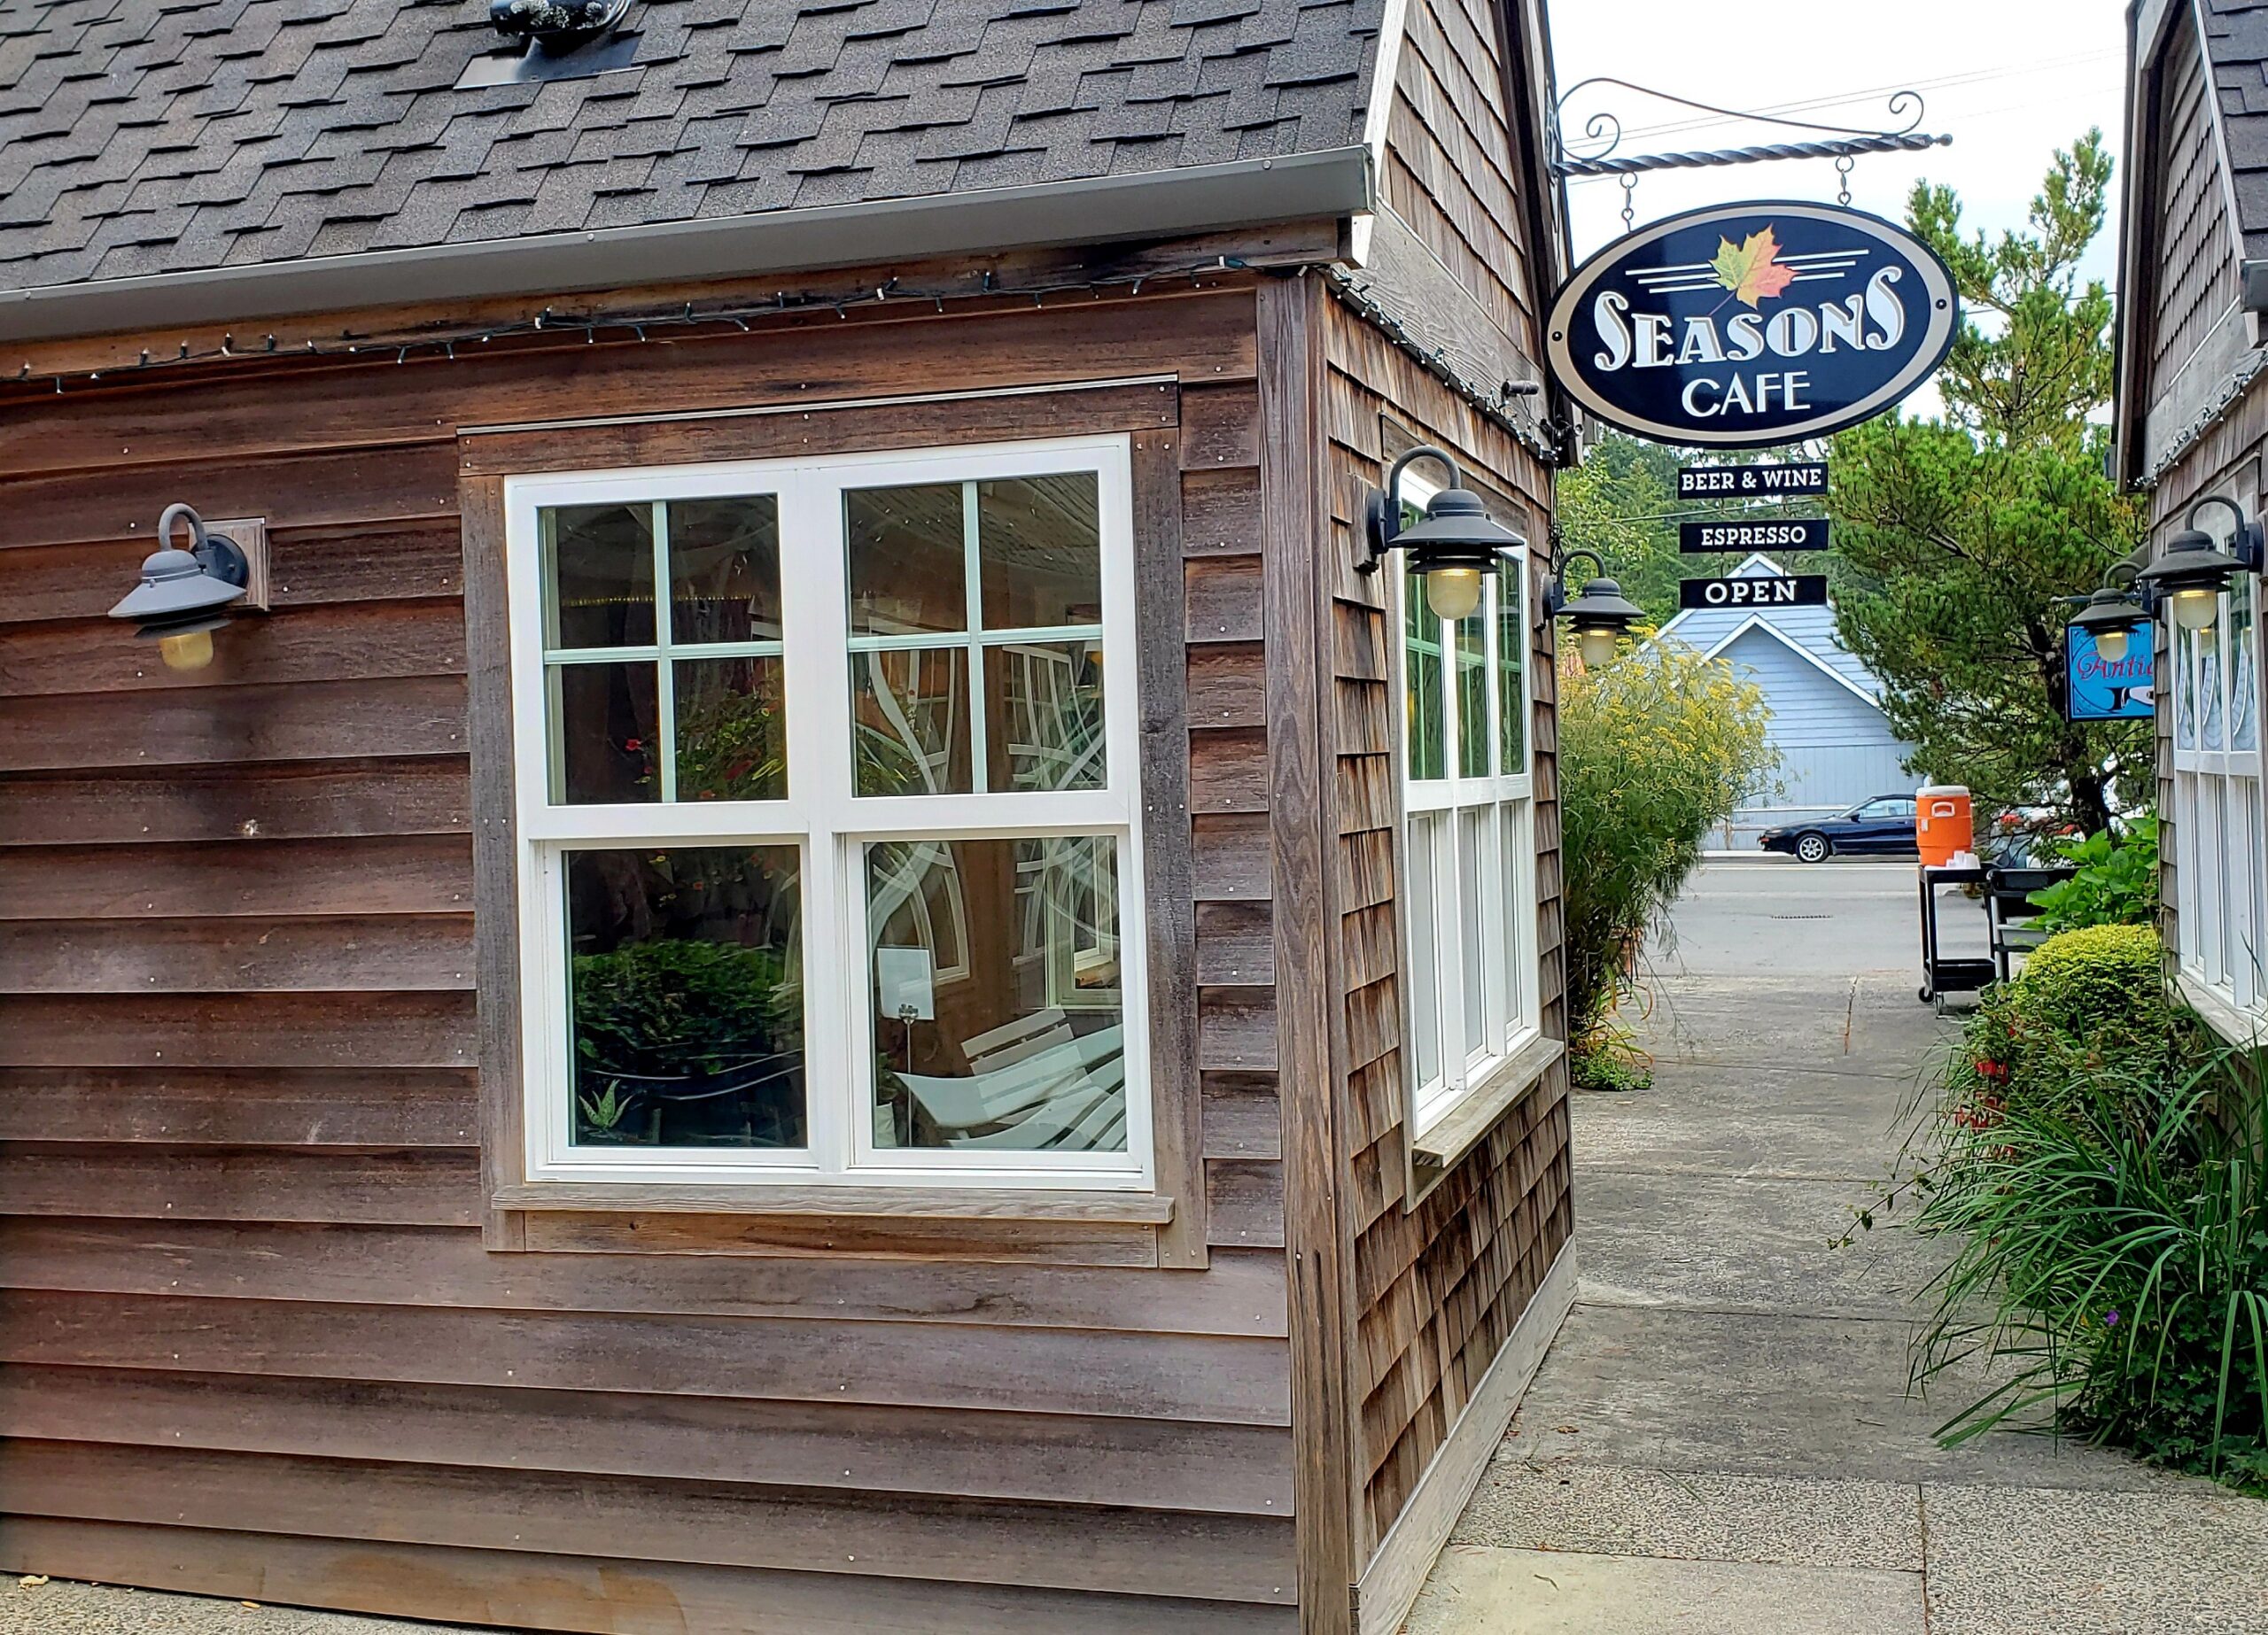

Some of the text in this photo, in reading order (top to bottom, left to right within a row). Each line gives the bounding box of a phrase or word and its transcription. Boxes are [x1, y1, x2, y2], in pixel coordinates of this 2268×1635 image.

[1594, 265, 1905, 372] SEASONS
[1682, 370, 1811, 417] CAFE
[1682, 469, 1821, 491] BEER & WINE
[1701, 526, 1806, 546] ESPRESSO
[1705, 580, 1797, 603] OPEN
